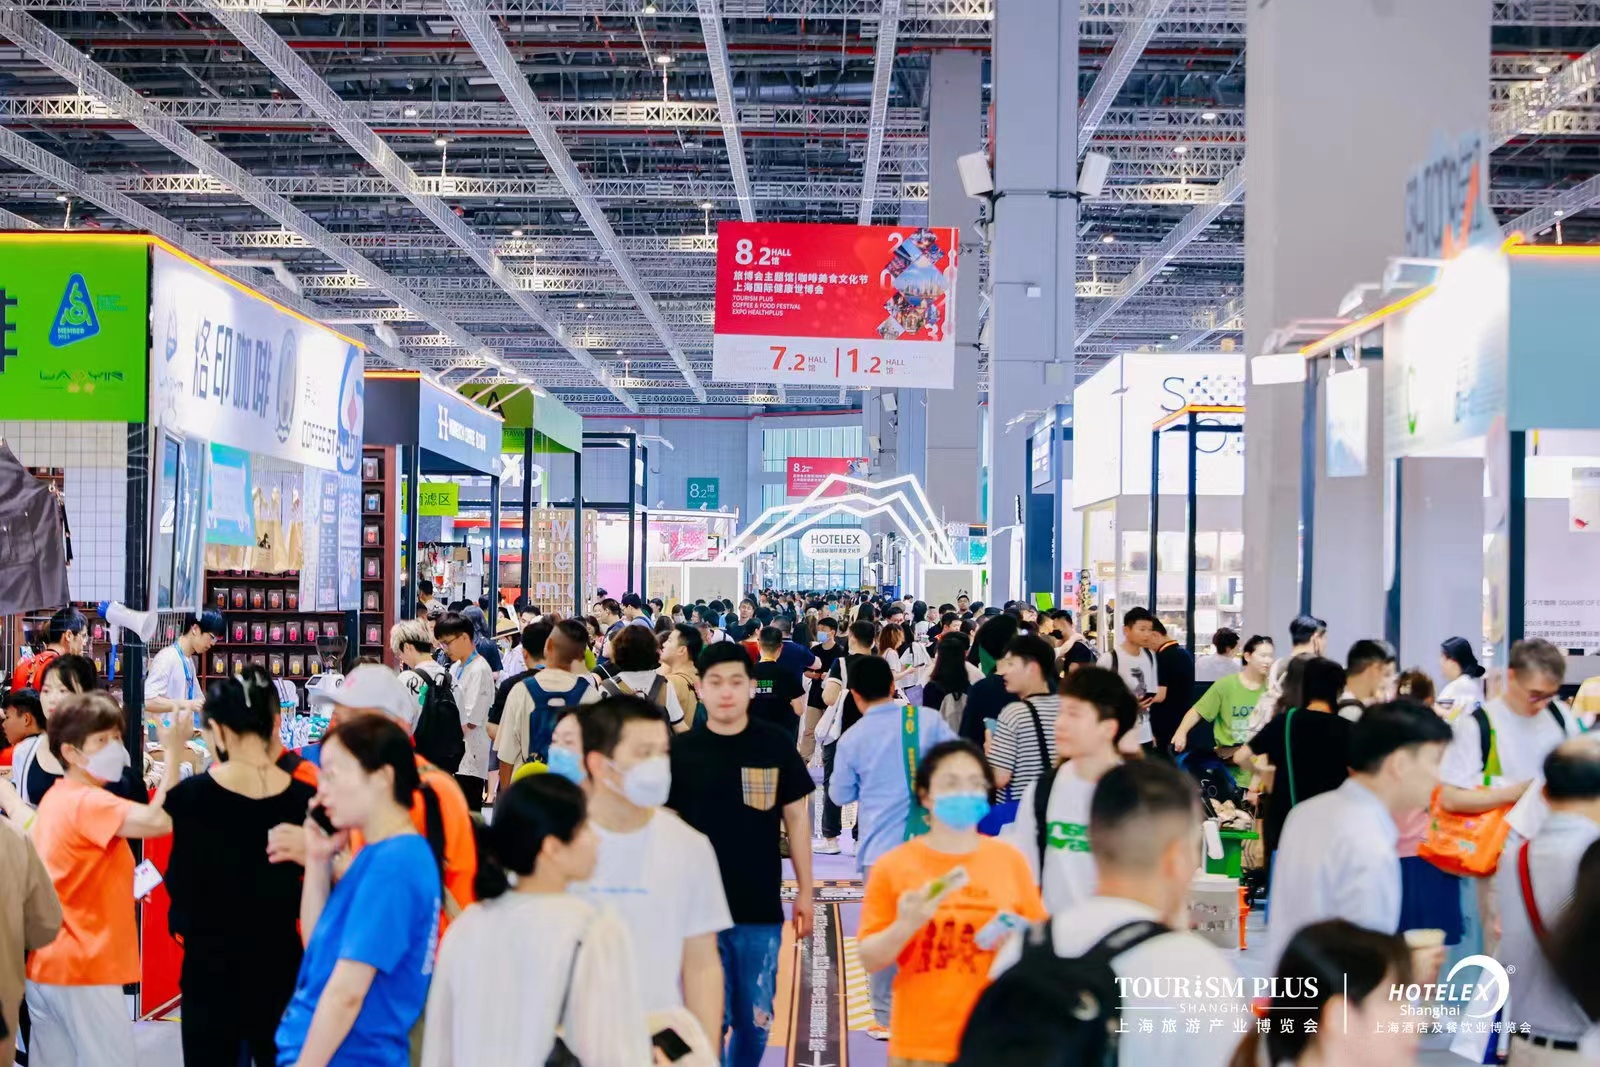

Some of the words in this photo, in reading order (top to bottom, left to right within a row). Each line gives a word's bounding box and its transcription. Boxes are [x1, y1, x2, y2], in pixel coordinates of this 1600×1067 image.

[735, 238, 771, 266] 8.2
[771, 248, 792, 257] HALL
[731, 294, 758, 302] TOURISM
[770, 346, 805, 372] 7.2
[808, 355, 828, 364] HALL
[847, 348, 881, 374] 1.2
[886, 358, 905, 367] HALL
[690, 483, 707, 498] 8.2
[811, 534, 861, 545] HOTELEX
